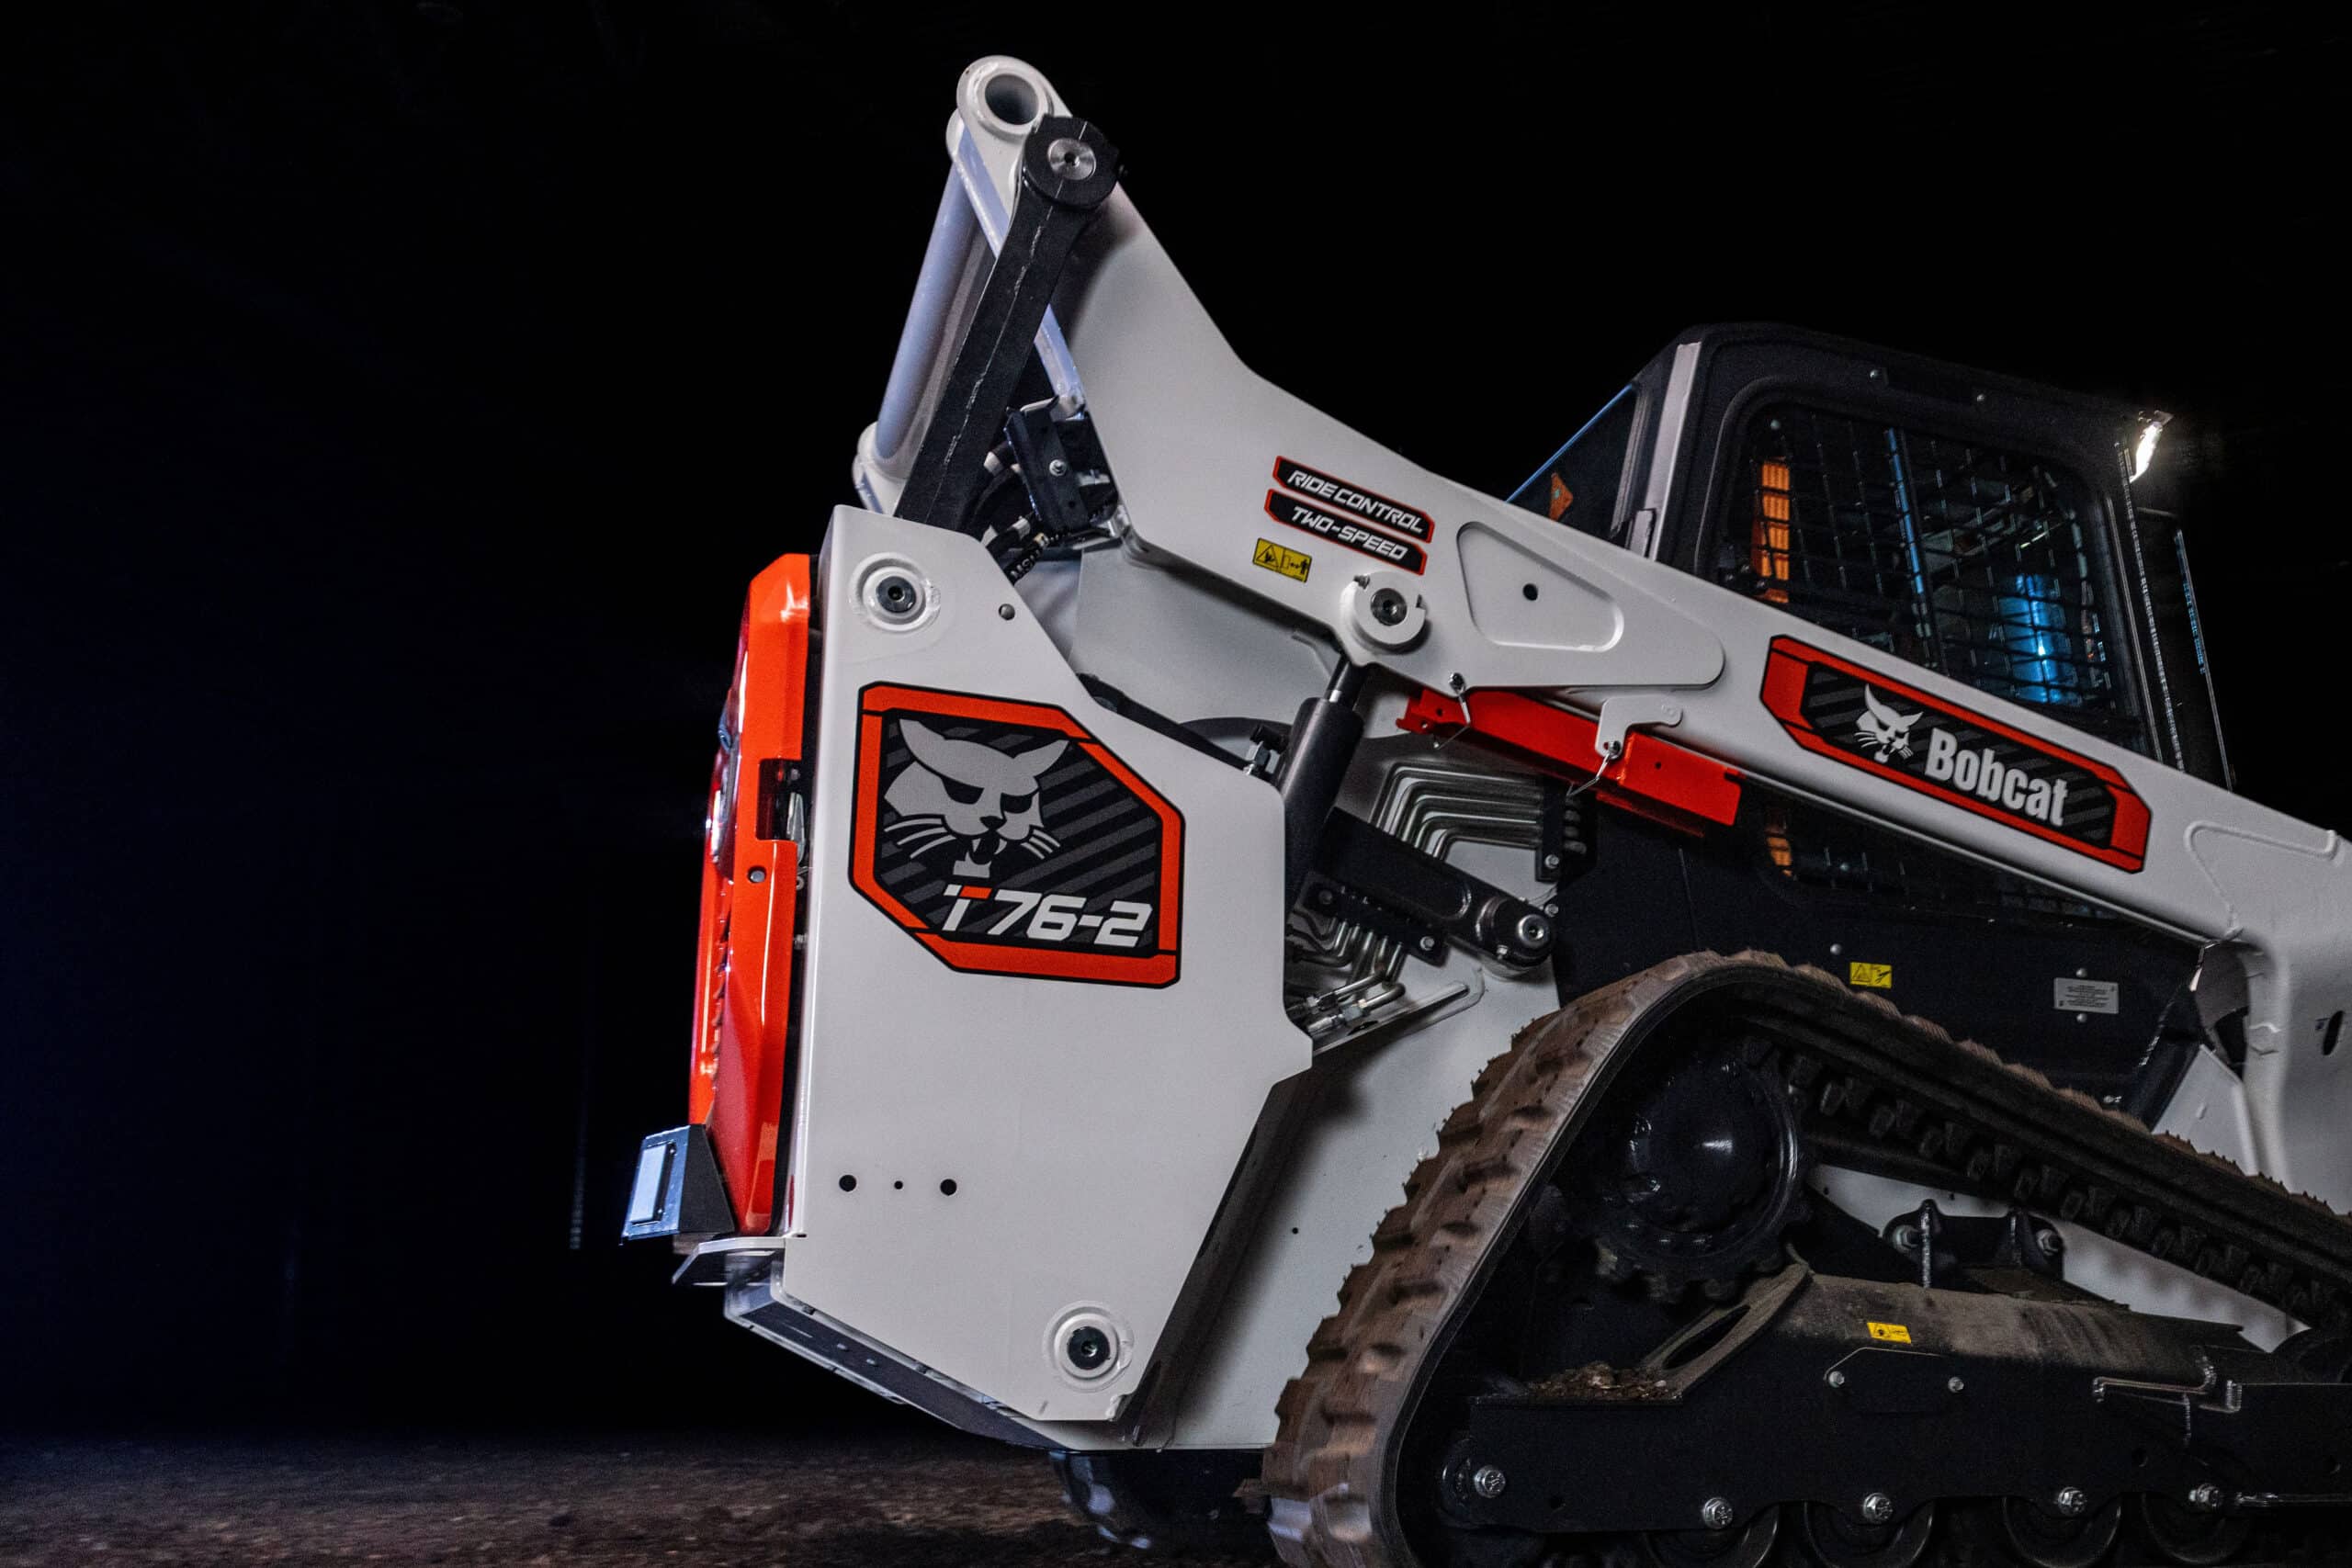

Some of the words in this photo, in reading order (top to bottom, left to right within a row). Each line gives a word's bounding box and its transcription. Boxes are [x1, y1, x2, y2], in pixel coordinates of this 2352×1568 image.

[1287, 469, 1338, 500] RIDE
[1334, 488, 1423, 534] CONTROL
[1291, 506, 1408, 560] TWO-SPEED
[1925, 727, 2068, 827] Bobcat
[942, 884, 1153, 948] T76-2
